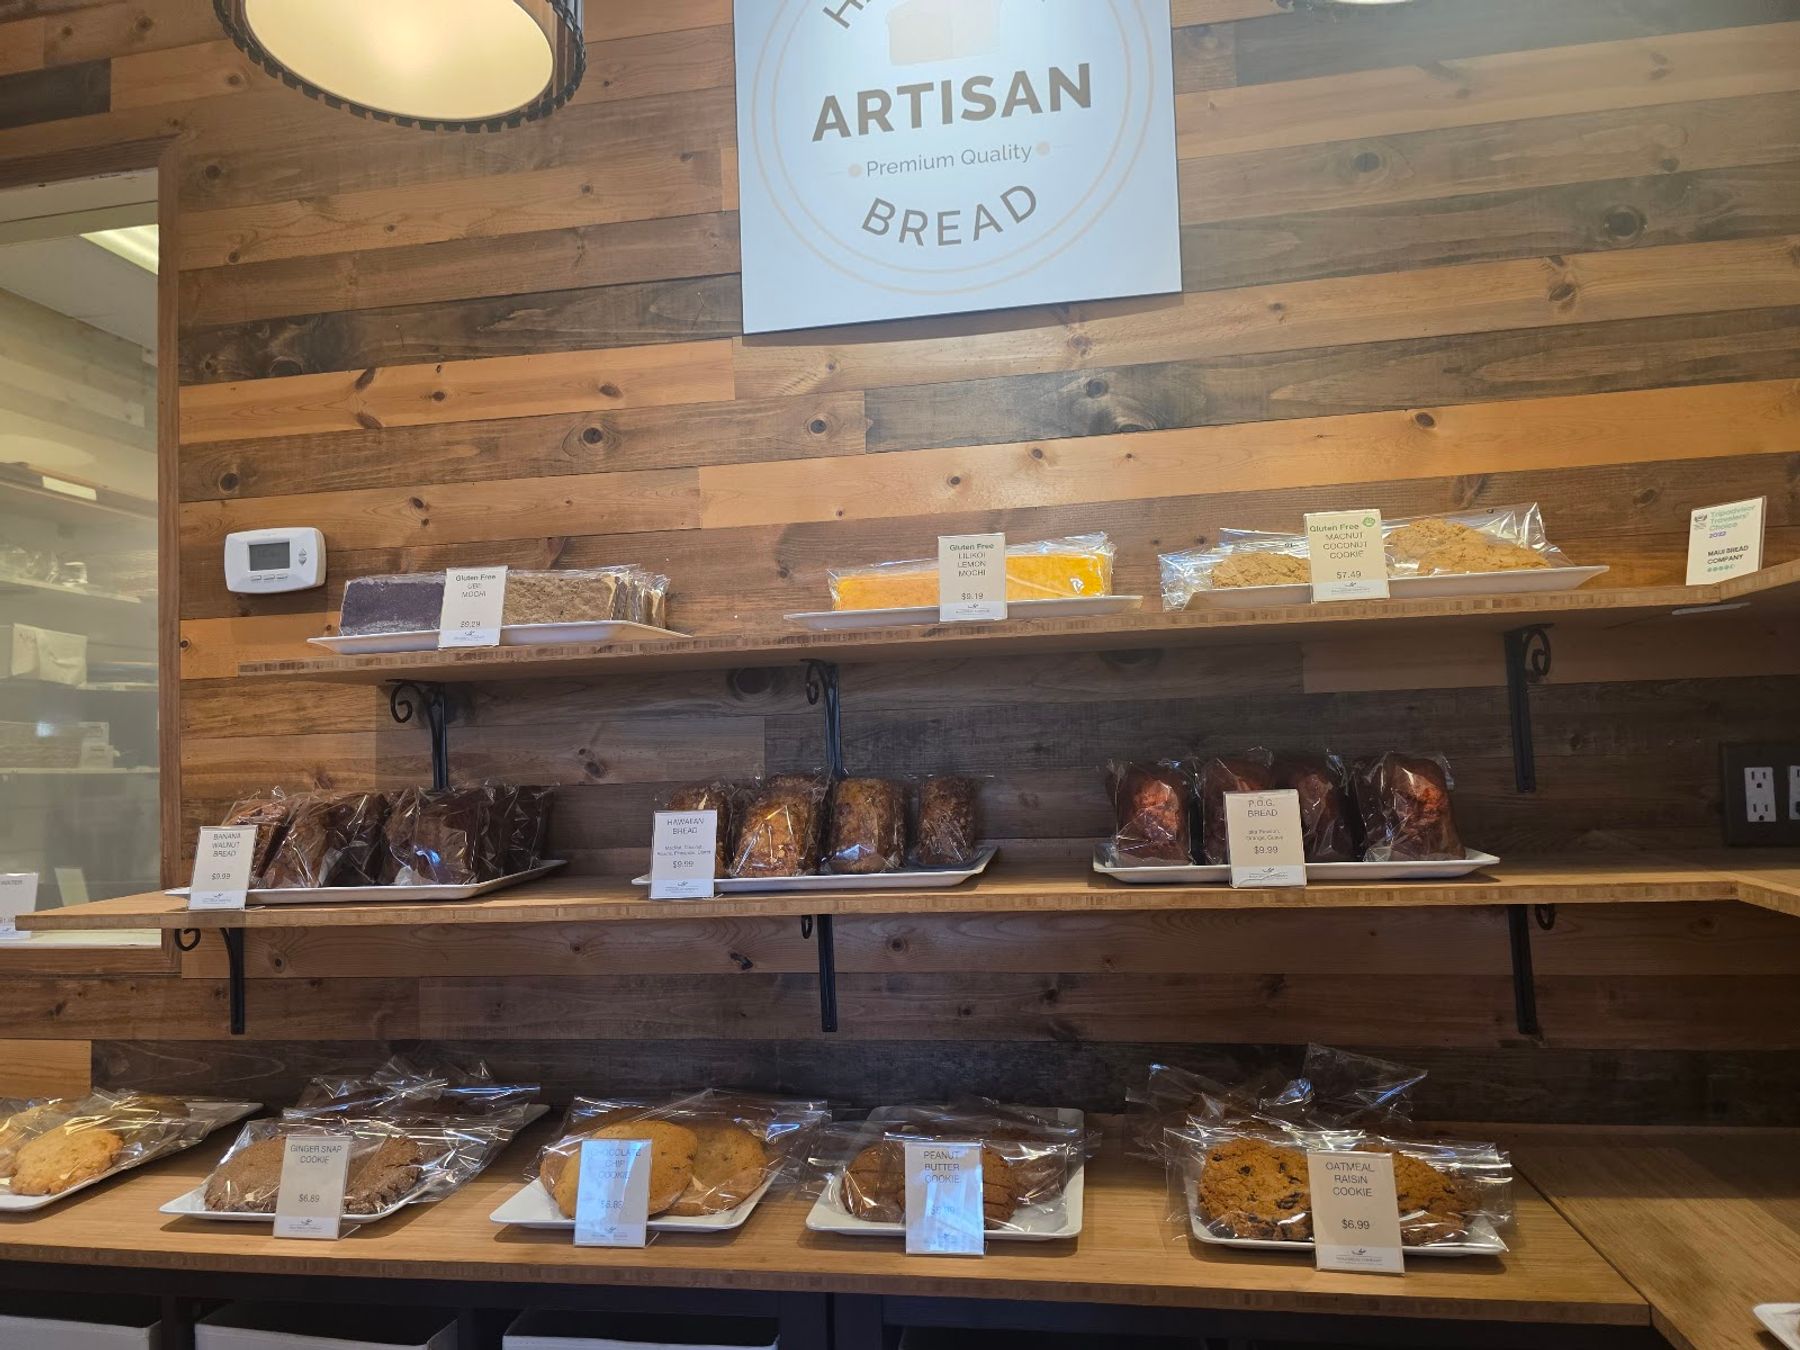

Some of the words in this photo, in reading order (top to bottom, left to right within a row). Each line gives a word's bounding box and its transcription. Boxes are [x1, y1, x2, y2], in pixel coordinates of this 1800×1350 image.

[812, 63, 1091, 142] ARTISAN
[866, 155, 955, 177] Premium
[961, 144, 1032, 166] Quality
[862, 185, 1037, 247] BREAD
[1325, 532, 1363, 540] MACNUT
[1323, 541, 1367, 550] COCONUT
[1330, 550, 1364, 559] COOKIE
[1708, 549, 1726, 557] MAUI
[1726, 545, 1749, 554] BREAD
[1707, 554, 1744, 564] COMPANY
[958, 569, 986, 577] MOCHI
[455, 574, 479, 582] Gluten
[1248, 799, 1275, 808] P.O.G.
[1247, 809, 1278, 817] BREAD
[672, 827, 698, 835] BREAD
[212, 841, 240, 849] WALNUT
[1254, 845, 1279, 854] $9.99
[290, 1144, 320, 1153] GINGER
[320, 1145, 342, 1154] SNAP
[300, 1155, 330, 1164] COOKIE
[923, 1150, 960, 1160] PEANUT
[924, 1163, 960, 1172] BUTTER
[1325, 1161, 1375, 1172] OATMEAL
[924, 1174, 961, 1184] COOKIE
[1334, 1174, 1368, 1184] RAISIN
[1332, 1186, 1373, 1197] COOKIE
[1342, 1218, 1371, 1230] $6.99
